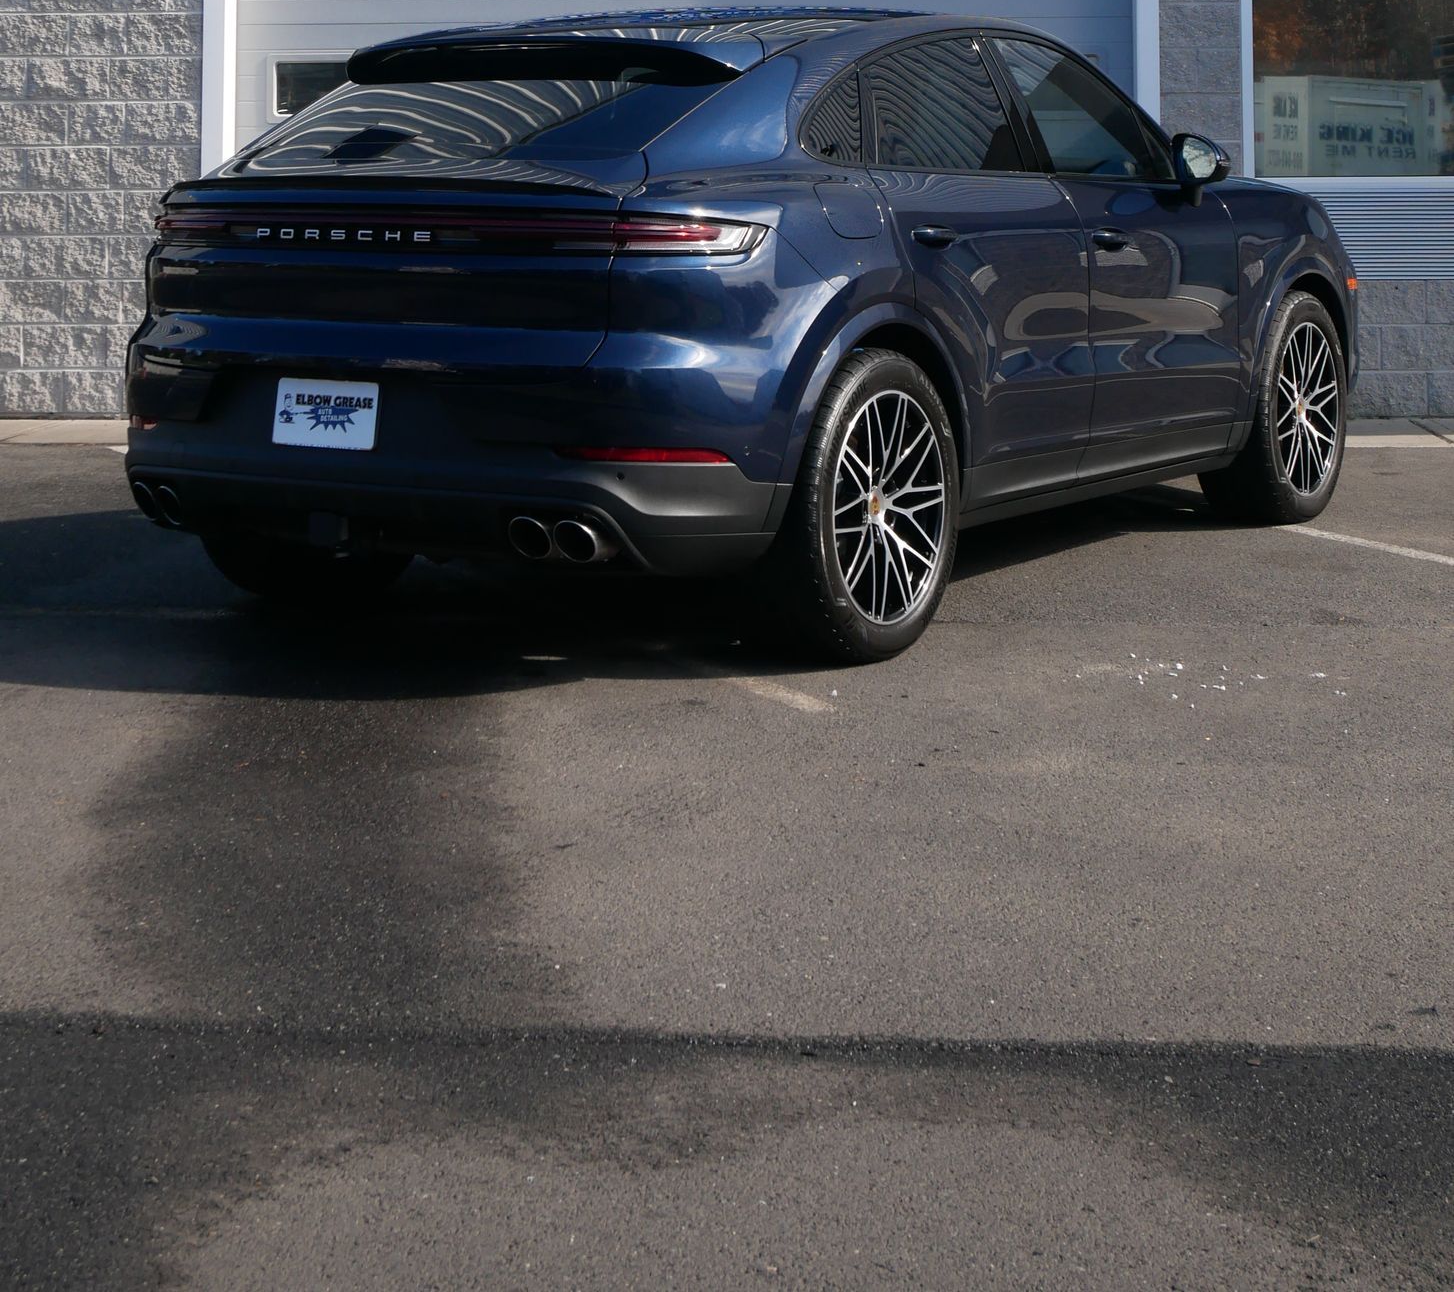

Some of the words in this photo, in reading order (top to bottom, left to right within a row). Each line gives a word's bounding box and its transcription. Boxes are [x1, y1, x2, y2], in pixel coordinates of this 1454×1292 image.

[257, 228, 431, 242] PORSCHE
[295, 393, 331, 407] ELBOW
[333, 395, 374, 409] GREASE
[320, 414, 348, 422] DETAILING
